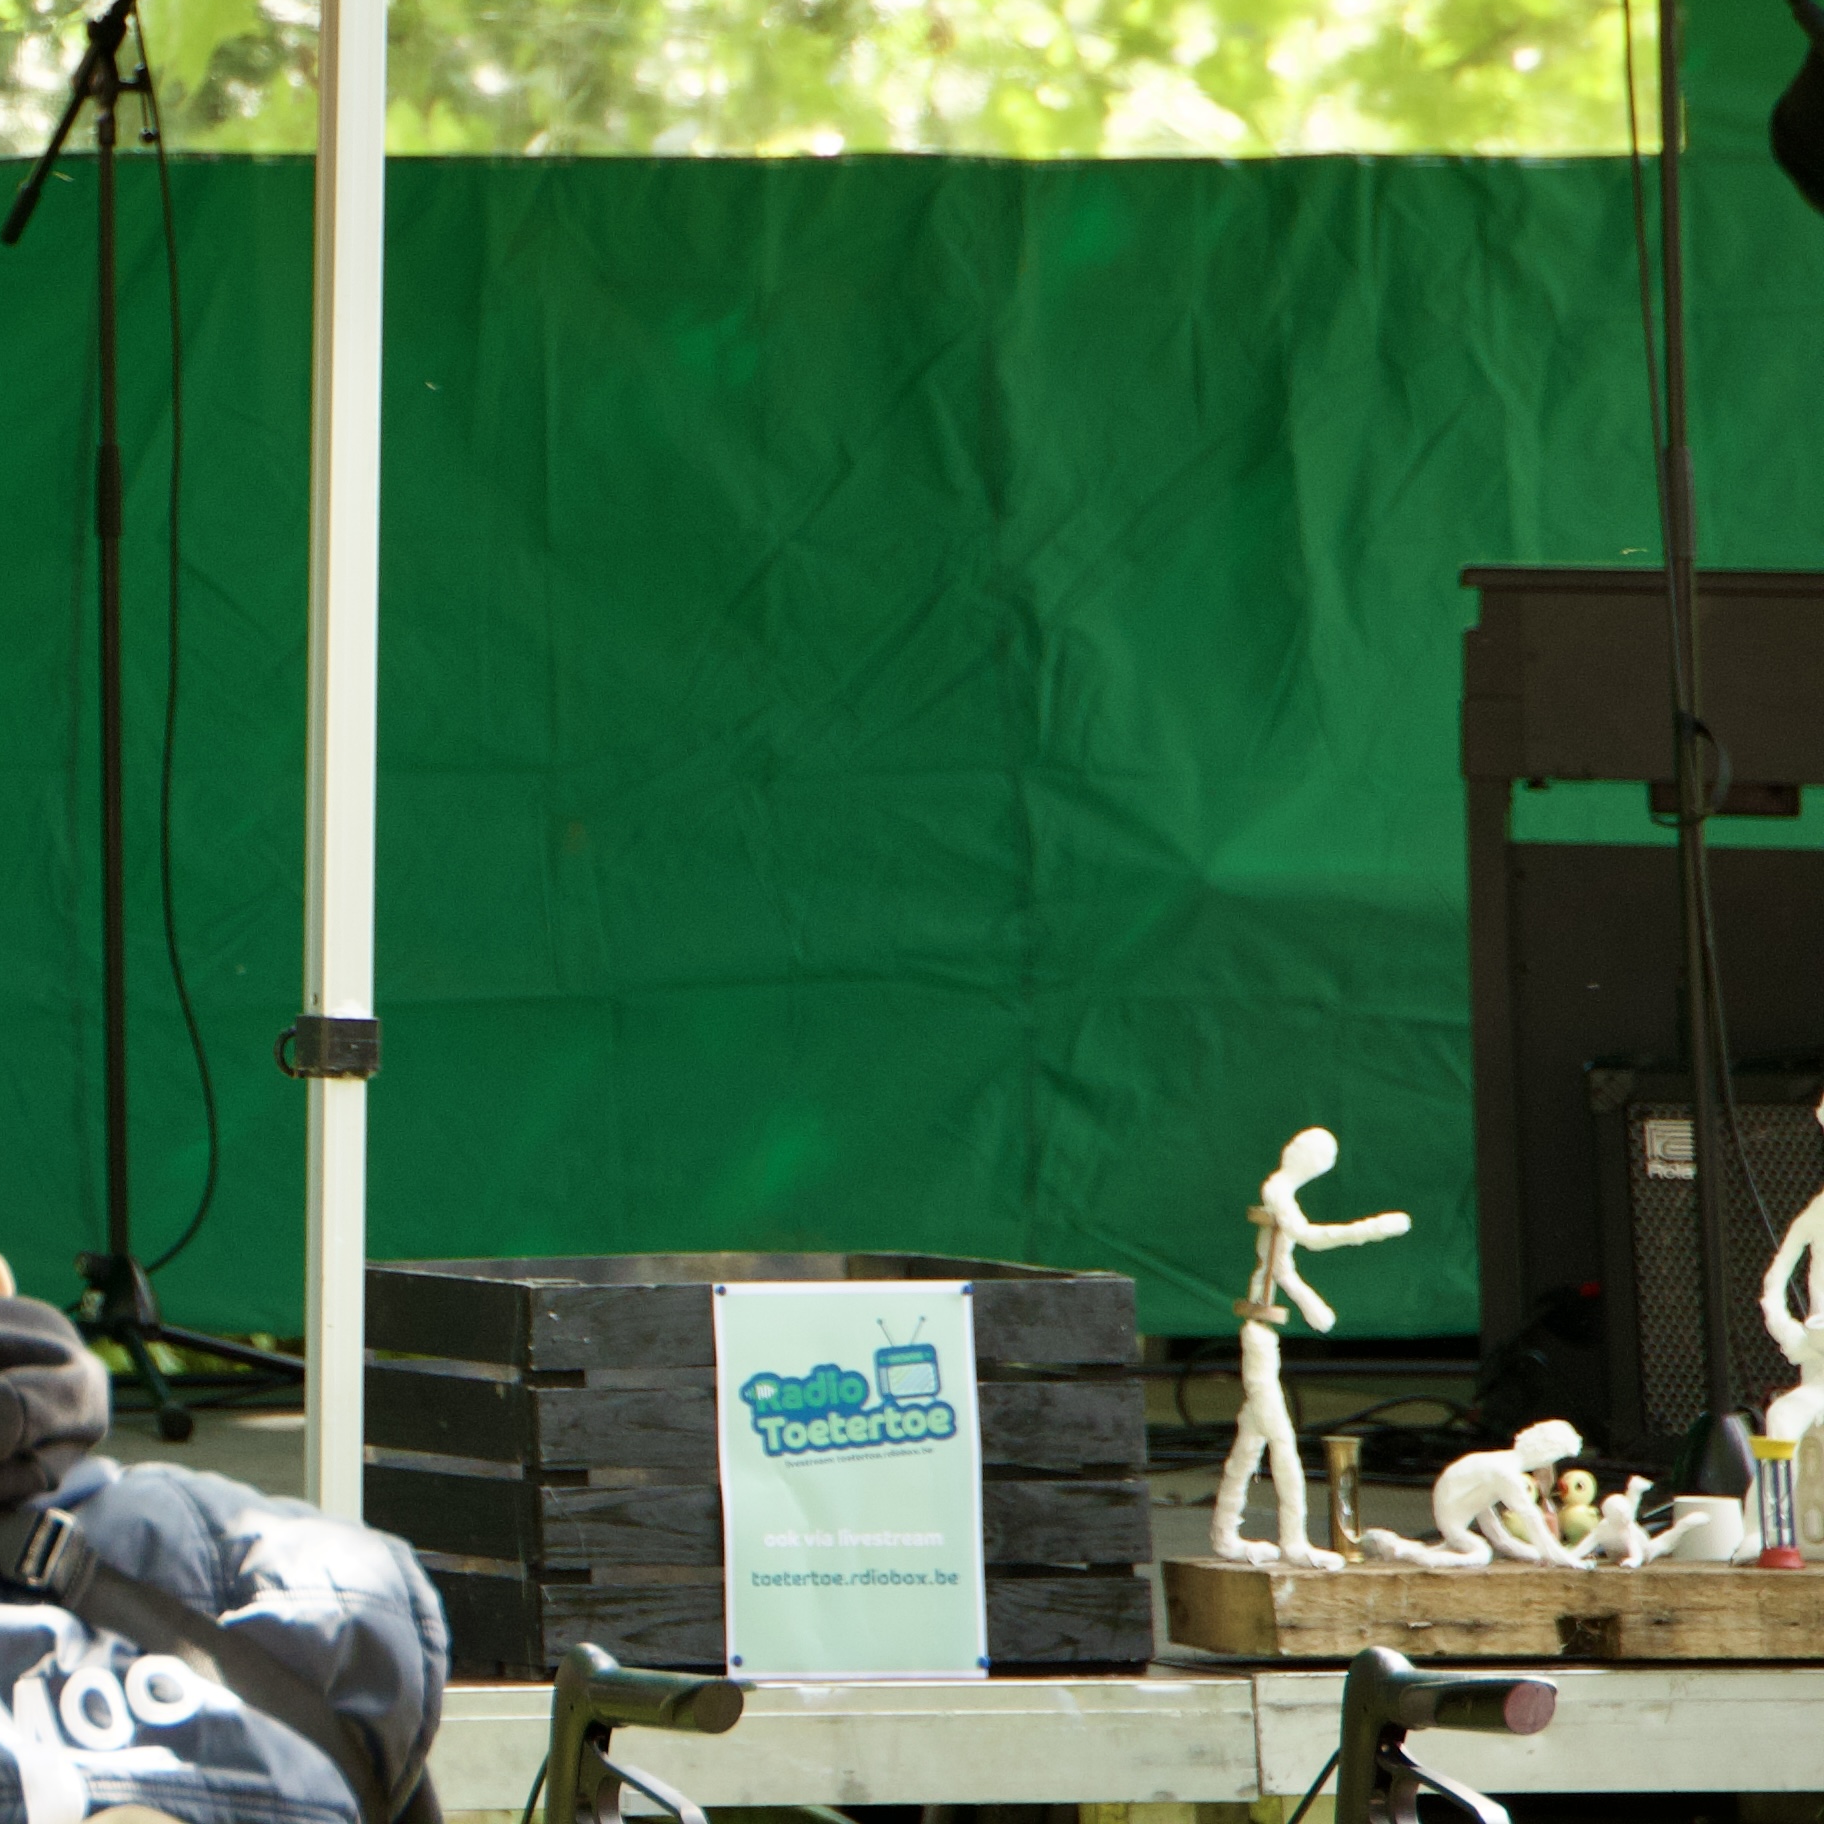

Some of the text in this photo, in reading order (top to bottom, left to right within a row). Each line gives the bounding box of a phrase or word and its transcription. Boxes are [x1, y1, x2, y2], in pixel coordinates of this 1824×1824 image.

[1647, 1162, 1696, 1180] Rola
[754, 1370, 866, 1413] Radio
[757, 1406, 952, 1452] Toetertoe
[763, 1528, 945, 1548] ook via livestream
[751, 1567, 960, 1587] toetertoe.rdiobox.be
